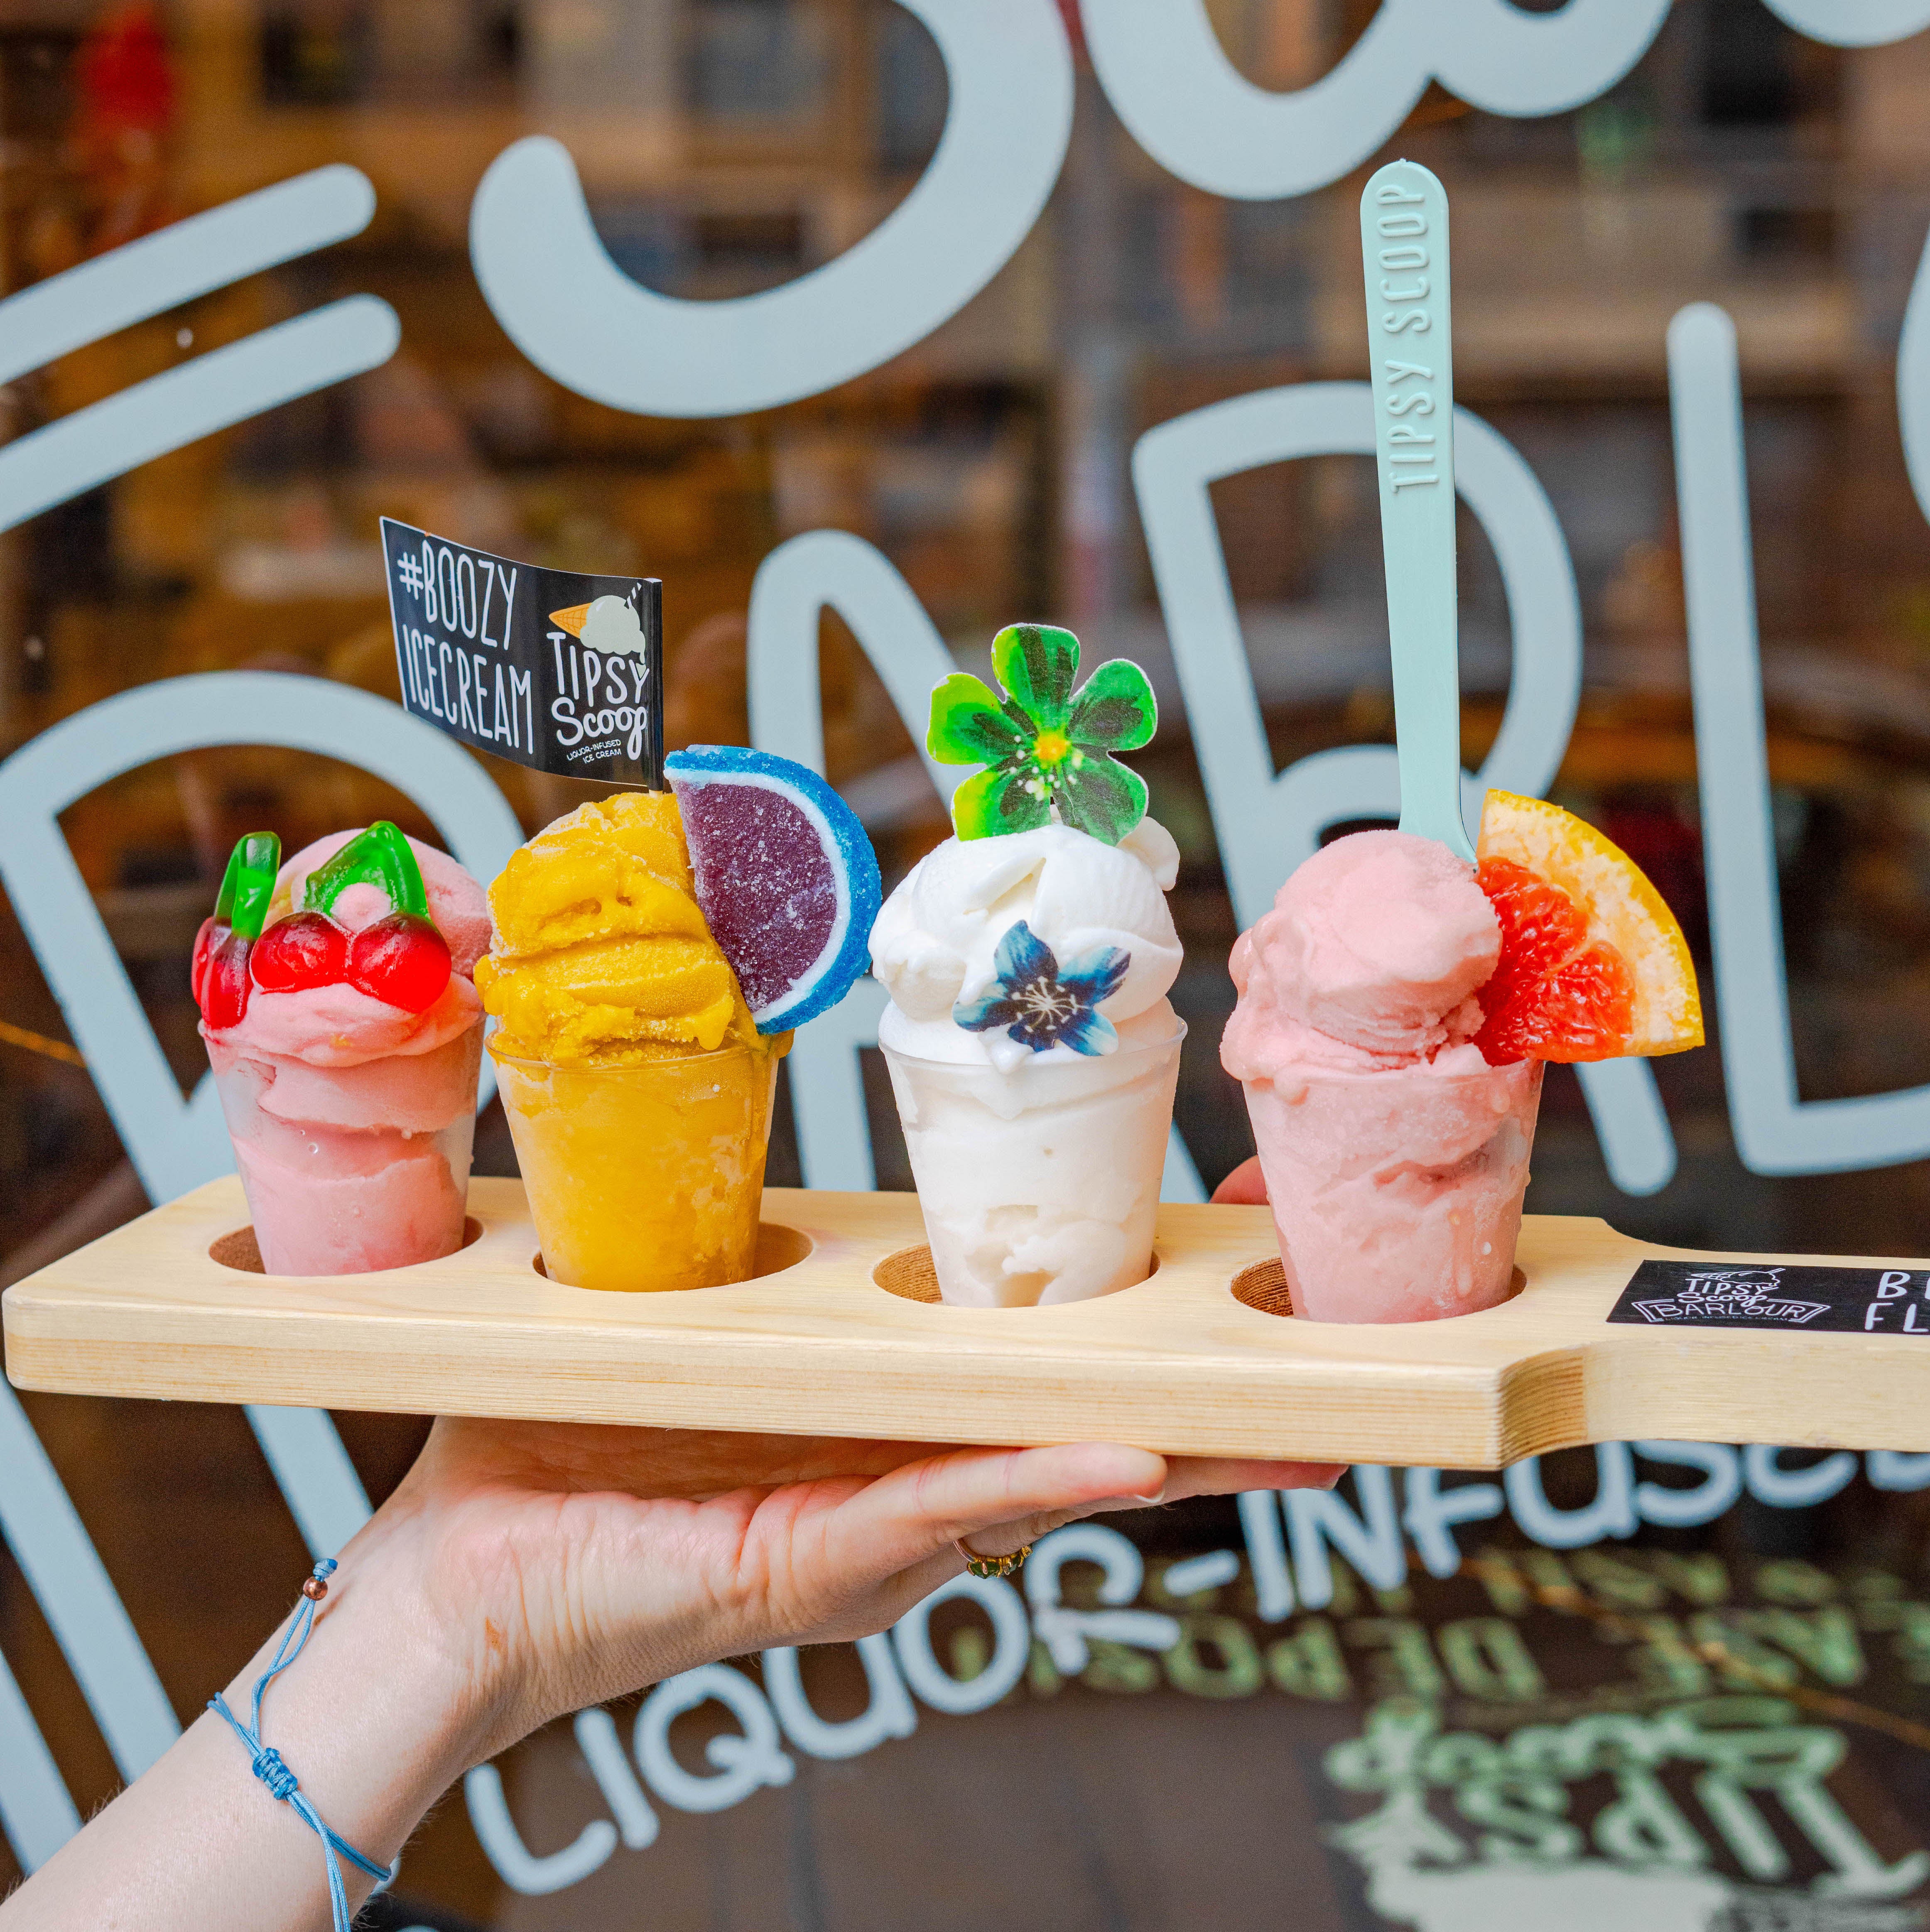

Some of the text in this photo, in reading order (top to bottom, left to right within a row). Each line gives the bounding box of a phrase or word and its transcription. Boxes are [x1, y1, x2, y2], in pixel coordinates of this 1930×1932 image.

[1376, 184, 1440, 494] TIPSY SCOOP
[397, 539, 517, 650] #BOOZY
[547, 632, 650, 707] TIPSY
[402, 624, 533, 754] ICECREAM
[551, 696, 647, 760] Scoop
[566, 739, 621, 761] LIQUOR-INFUSED
[583, 748, 621, 764] ICE CREAM
[1676, 1292, 1768, 1307] Scoop
[1685, 1278, 1779, 1295] TIPSY
[1876, 1271, 1930, 1300] B
[1648, 1303, 1806, 1317] BARLOUR
